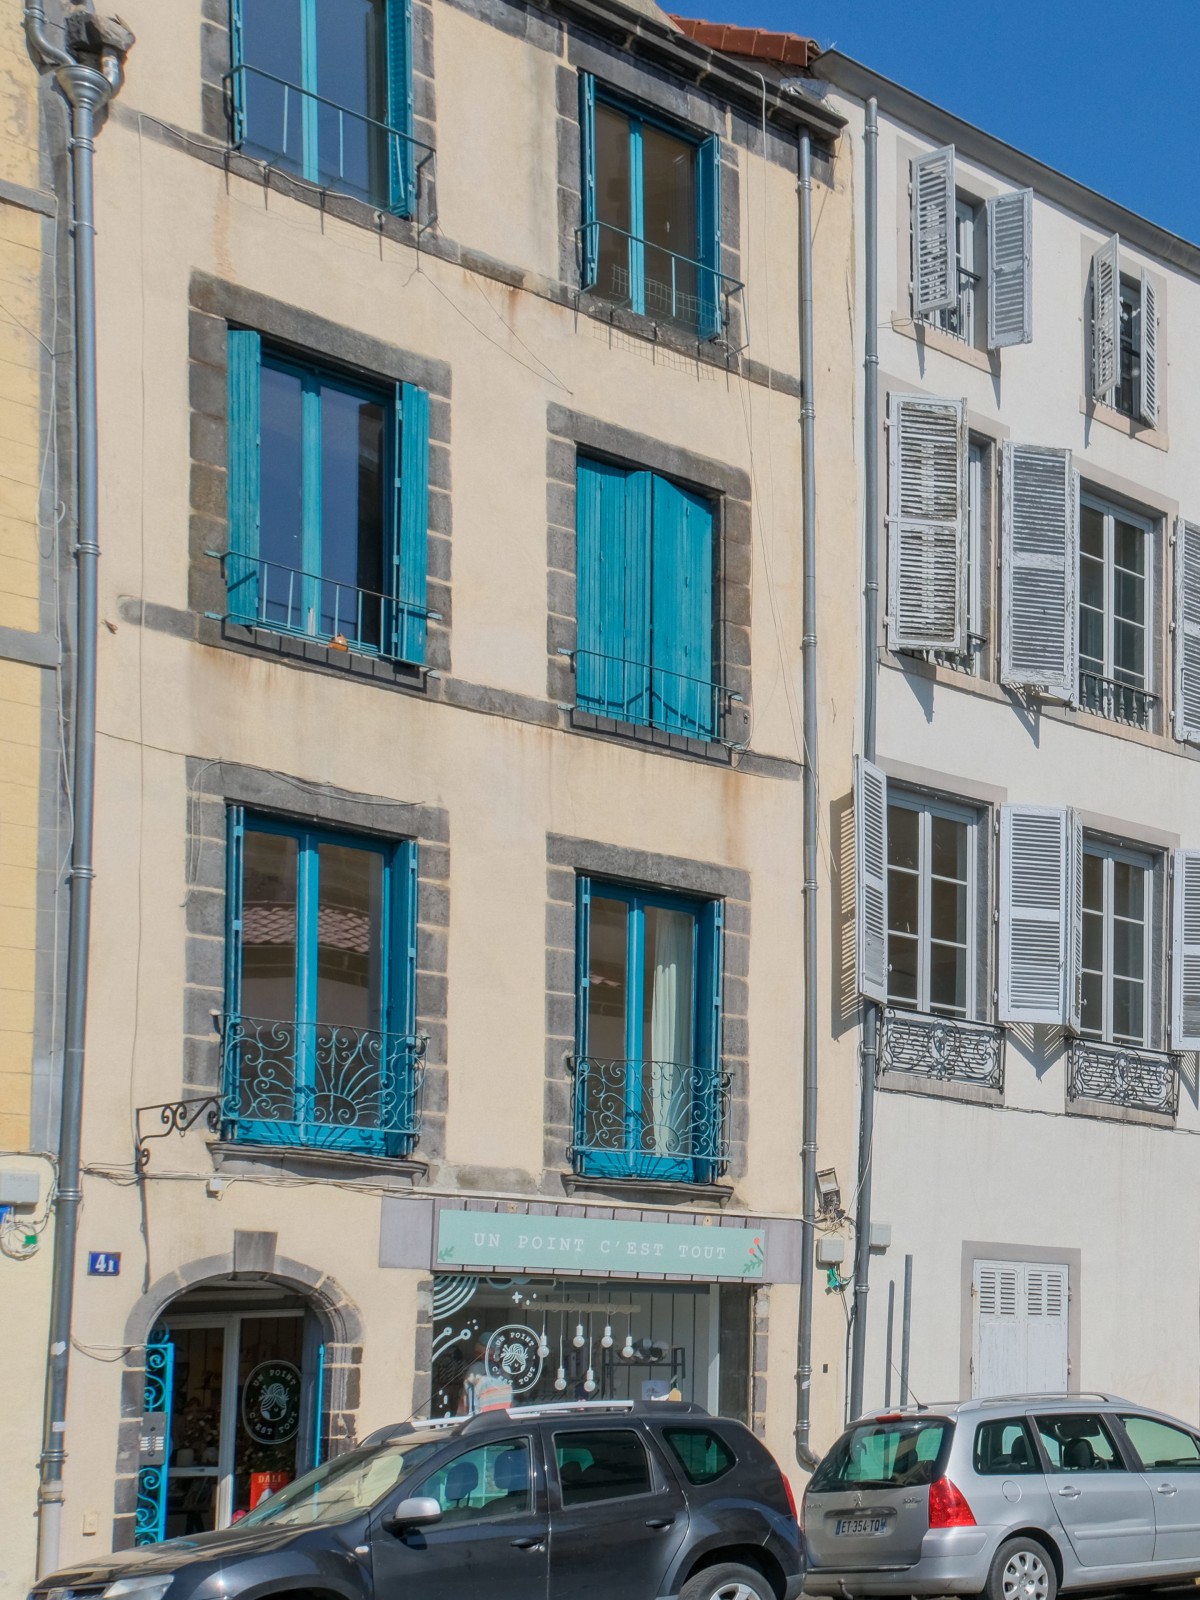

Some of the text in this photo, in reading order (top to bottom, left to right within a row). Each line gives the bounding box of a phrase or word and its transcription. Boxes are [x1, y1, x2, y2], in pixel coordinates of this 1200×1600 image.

[474, 1232, 727, 1260] UN POINT C'EST TOUT
[95, 1254, 114, 1273] 41
[495, 1332, 535, 1347] UN POINT
[252, 1369, 297, 1387] UN POINT
[518, 1366, 536, 1385] TOUT
[278, 1411, 298, 1434] TOUT
